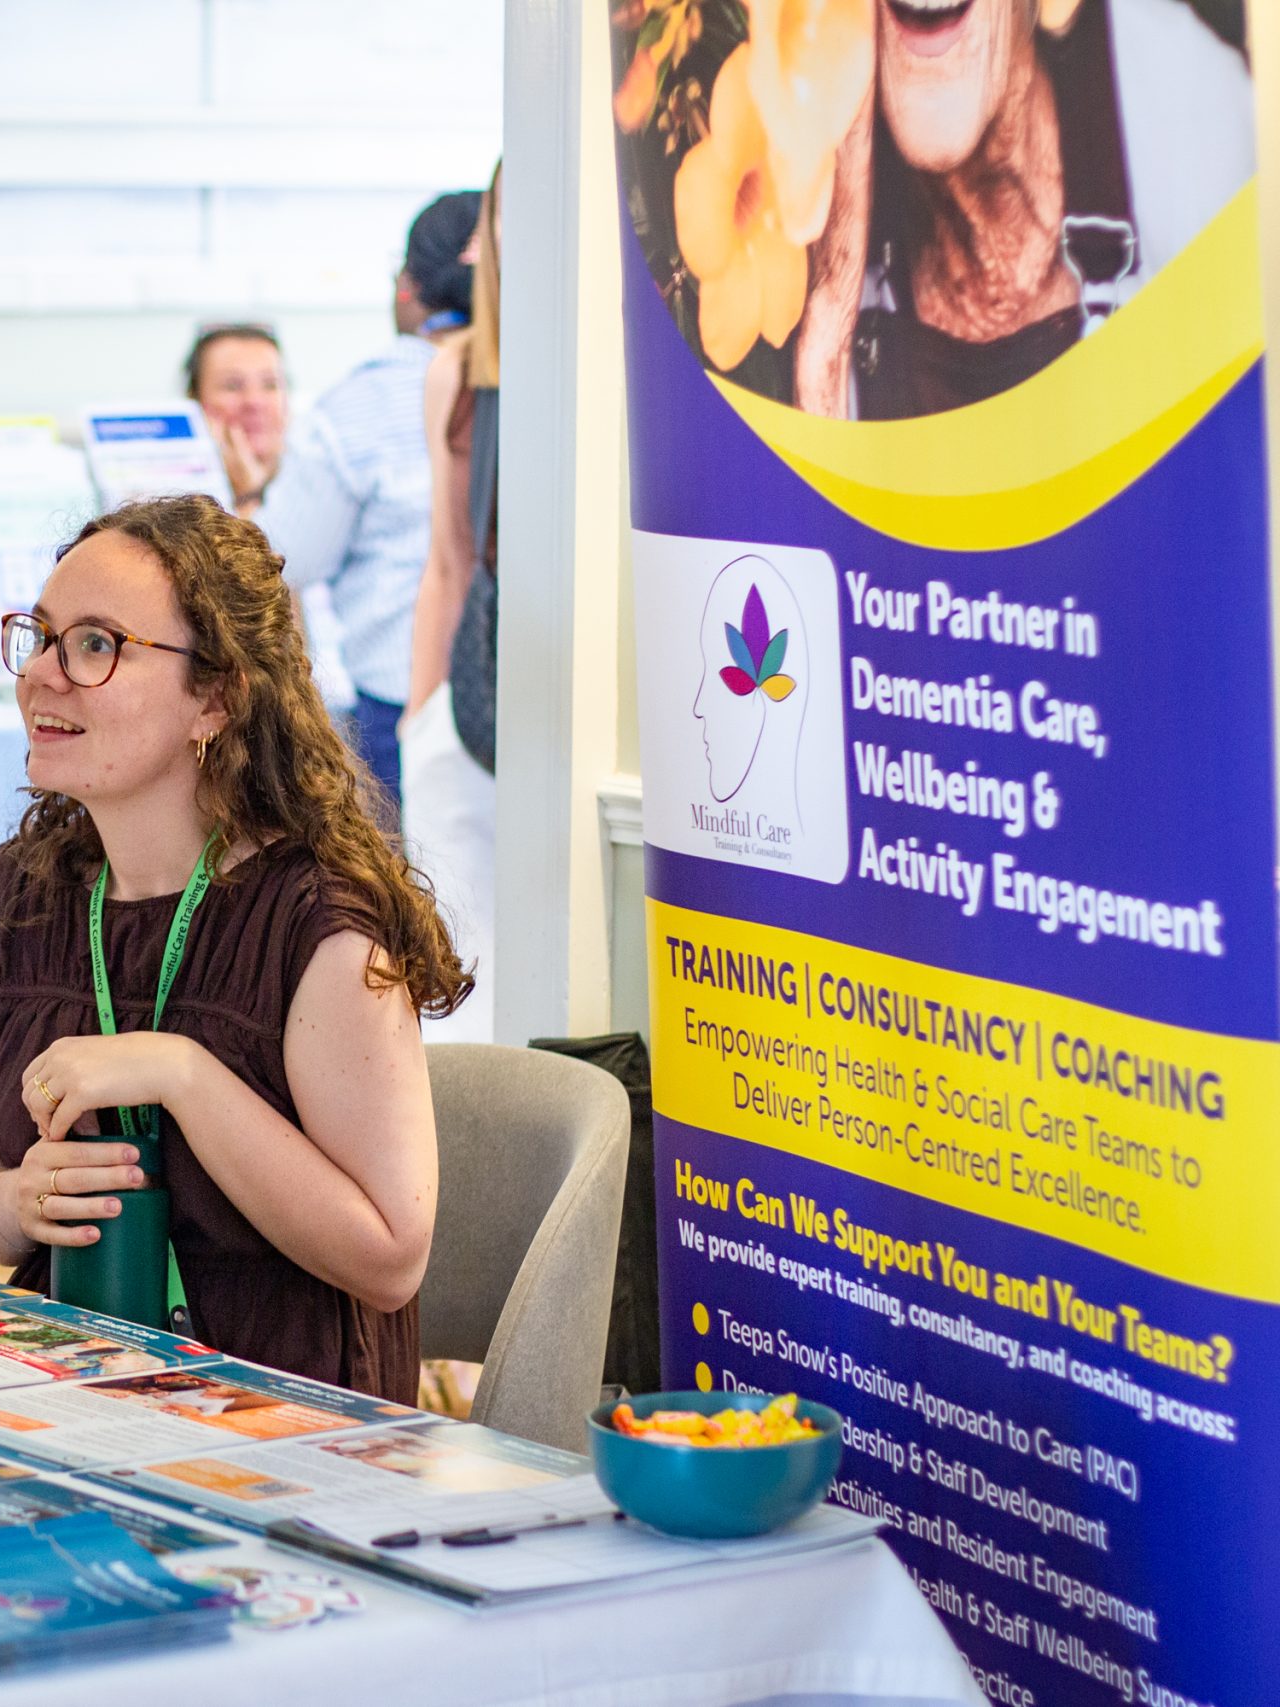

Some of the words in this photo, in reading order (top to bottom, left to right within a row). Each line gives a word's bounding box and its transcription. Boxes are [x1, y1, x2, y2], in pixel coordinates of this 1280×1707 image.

[845, 570, 920, 632] Your
[926, 580, 1059, 650] Partner
[1063, 596, 1097, 657] in
[851, 656, 1013, 733] Dementia
[1021, 680, 1106, 758] Care,
[691, 803, 751, 838] Mindful
[756, 813, 791, 845] Care
[714, 836, 743, 857] Training
[854, 741, 1025, 837] Wellbeing
[1033, 771, 1059, 829] &
[179, 882, 206, 924] Training
[197, 872, 208, 882] &
[859, 827, 984, 917] Activity
[992, 852, 1223, 957] Engagement
[666, 936, 797, 1006] TRAINING
[819, 972, 1026, 1066] CONSULTANCY
[1051, 1031, 1226, 1121] COACHING
[684, 1006, 828, 1088] Empowering
[834, 1044, 907, 1103] Health
[913, 1068, 929, 1108] &
[936, 1074, 1013, 1133] Social
[1020, 1097, 1078, 1151] Care
[1083, 1113, 1163, 1180] Teams
[1170, 1145, 1202, 1190] to
[733, 1071, 812, 1127] Deliver
[819, 1094, 1002, 1188] Person-Centred
[1010, 1151, 1147, 1236] Excellence.
[674, 1158, 730, 1211] How
[736, 1177, 786, 1229] Can
[790, 1192, 829, 1243] We
[833, 1208, 933, 1281] Support
[935, 1242, 988, 1300] You
[994, 1274, 1048, 1319] and
[1053, 1279, 1117, 1343] Your
[1120, 1304, 1234, 1385] Teams?
[678, 1217, 704, 1252] We
[708, 1232, 776, 1275] provide
[779, 1256, 832, 1292] expert
[835, 1271, 906, 1328] training,
[908, 1303, 1025, 1369] consultancy,
[1029, 1348, 1066, 1379] and
[1070, 1358, 1154, 1422] coaching
[1156, 1394, 1236, 1443] across:
[717, 1308, 773, 1357] Teepa
[777, 1329, 838, 1380] Snow's
[841, 1351, 909, 1408] Positive
[912, 1380, 1003, 1445] Approach
[1007, 1420, 1030, 1454] to
[1034, 1427, 1083, 1474] Care
[1087, 1445, 1140, 1502] (PAC)
[909, 1442, 923, 1475] &
[926, 1448, 967, 1494] Staff
[971, 1467, 1109, 1552] Development
[827, 1477, 902, 1531] Activities
[908, 1510, 942, 1547] and
[946, 1519, 1028, 1584] Resident
[1032, 1555, 1159, 1642] Engagement
[967, 1592, 981, 1626] &
[984, 1602, 1030, 1648] Staff
[1034, 1620, 1133, 1703] Wellbeing
